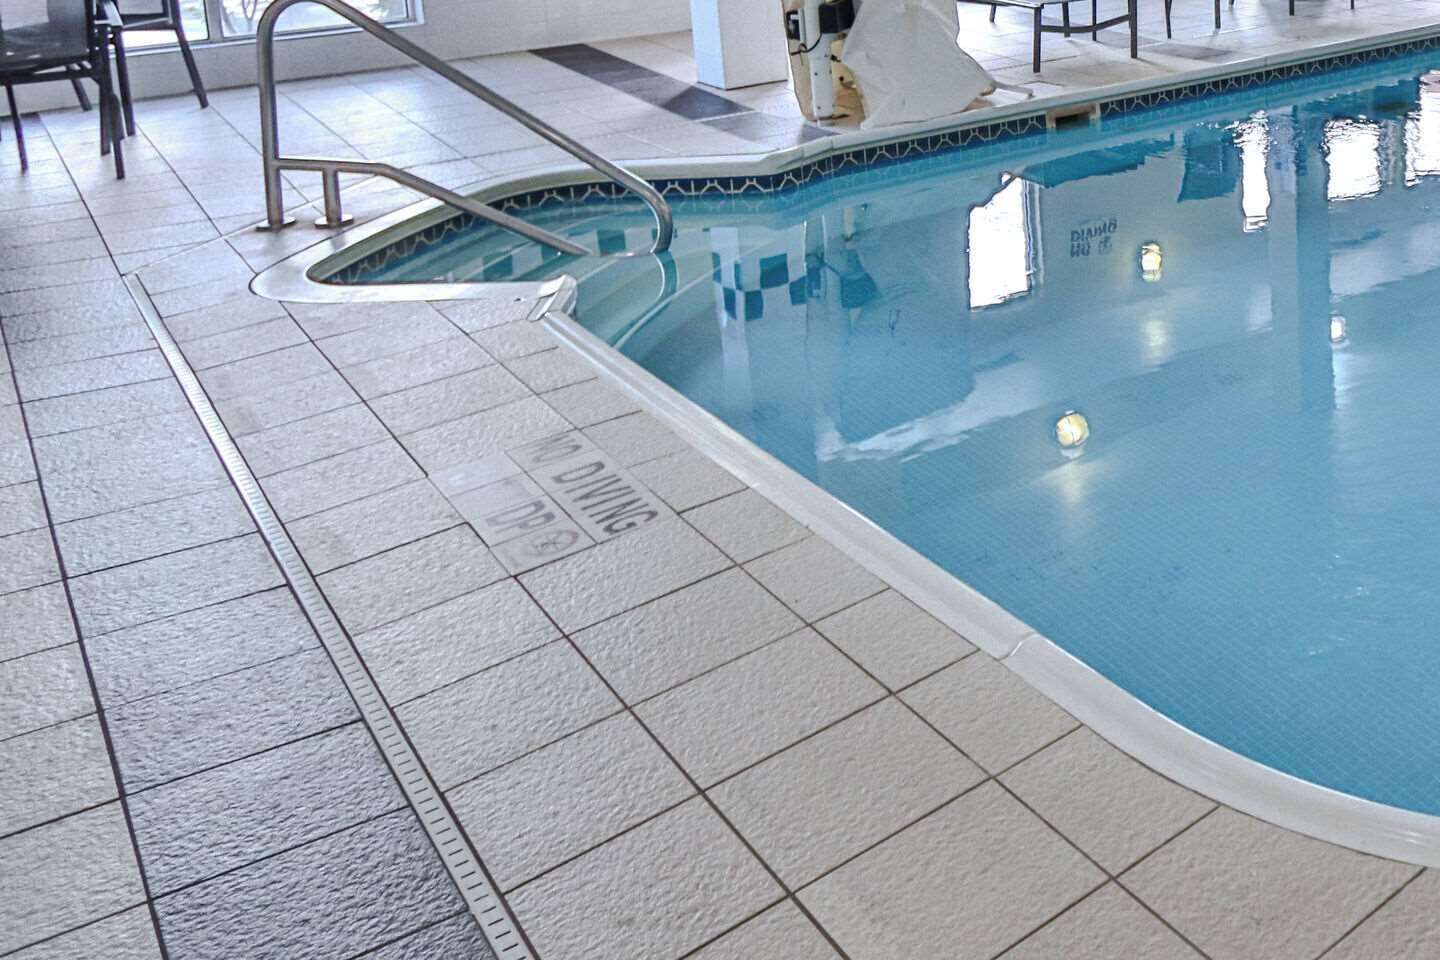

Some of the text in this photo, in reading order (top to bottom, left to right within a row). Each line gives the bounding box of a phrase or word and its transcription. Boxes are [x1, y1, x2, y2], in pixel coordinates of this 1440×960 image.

[523, 431, 659, 534] NO DIVING
[485, 500, 556, 535] DP
